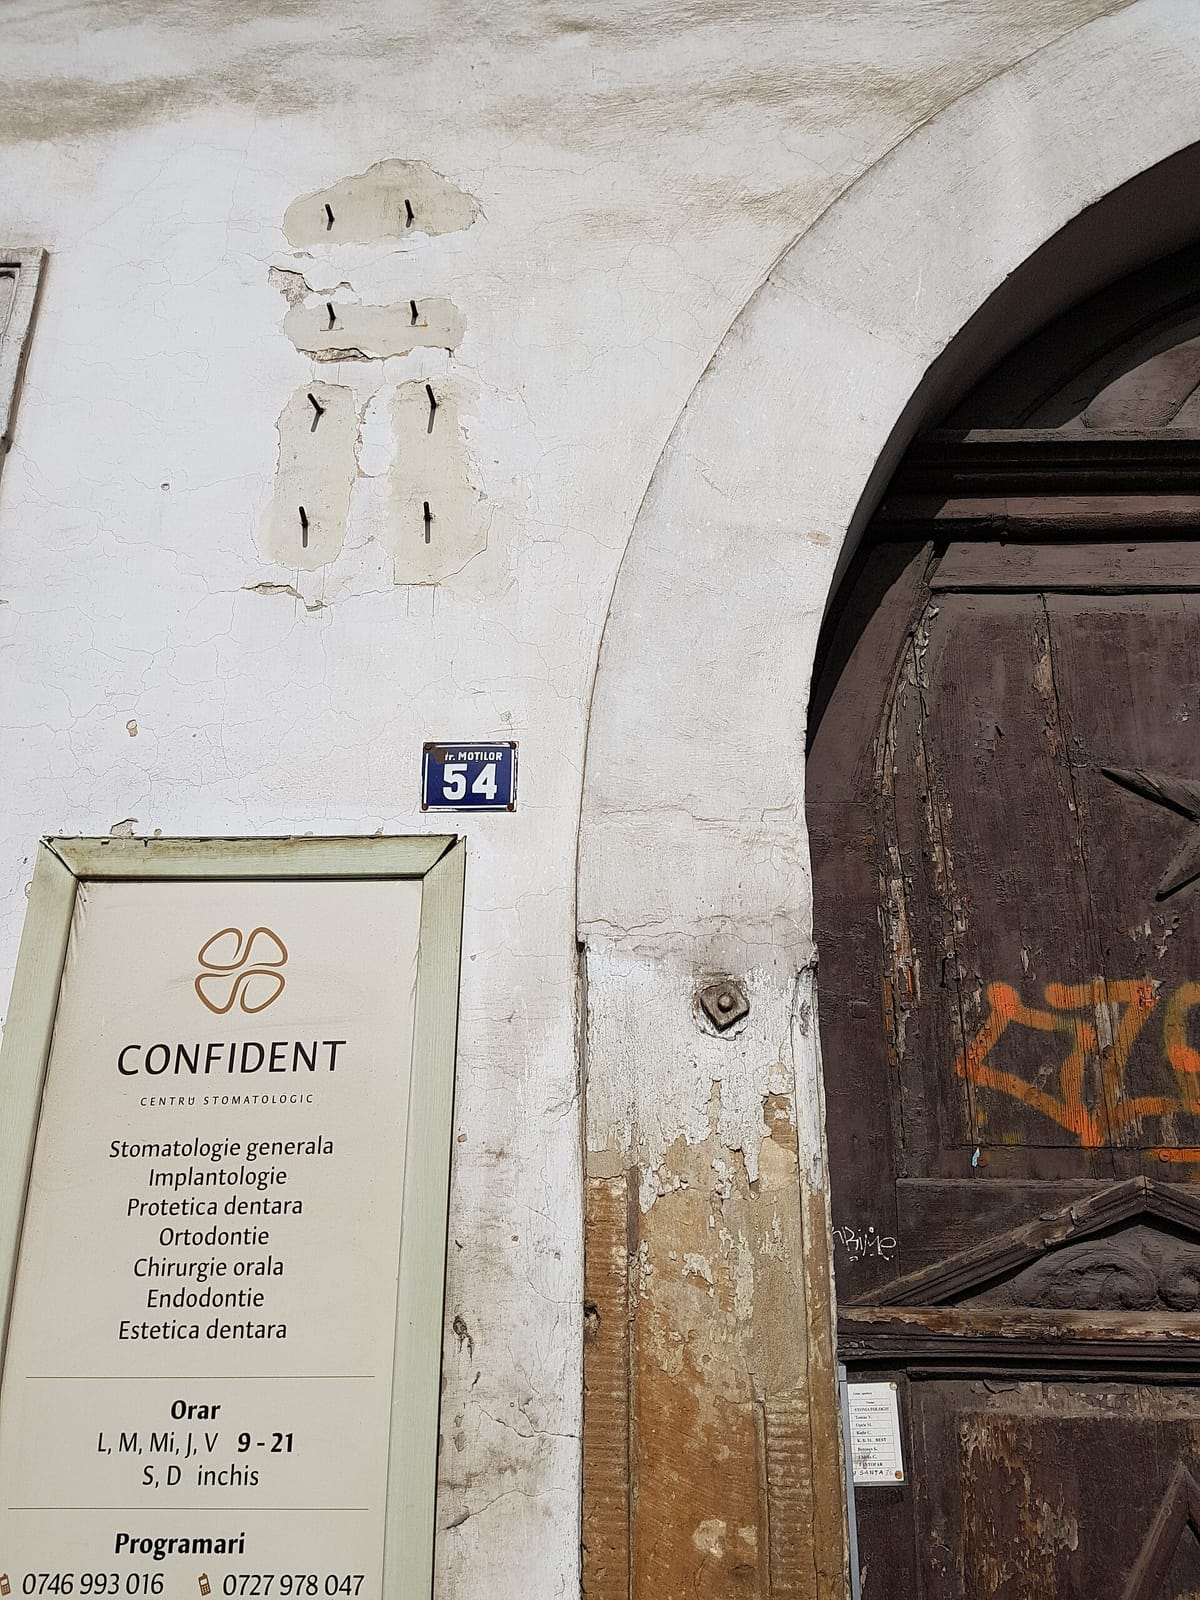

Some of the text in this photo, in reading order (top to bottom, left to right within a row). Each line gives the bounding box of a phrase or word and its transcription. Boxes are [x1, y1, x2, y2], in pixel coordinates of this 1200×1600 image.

[443, 763, 498, 800] 54
[117, 1040, 347, 1076] CONFIDENT
[140, 1094, 313, 1107] CENTRU STOMATOLOGIC
[109, 1134, 334, 1163] Stomatologie generala
[149, 1165, 287, 1192] Implantologie
[127, 1194, 303, 1217] Protetica dentara
[159, 1225, 270, 1247] Ortodontie
[133, 1254, 284, 1283] Chirurgie orala
[147, 1286, 265, 1308] Endodontie
[118, 1317, 287, 1340] Estetica dentara
[170, 1399, 222, 1420] Orar
[142, 1463, 259, 1489] S, D inchis
[114, 1531, 246, 1561] Programari
[22, 1572, 365, 1596] 0746 993 016 0727 978 047
